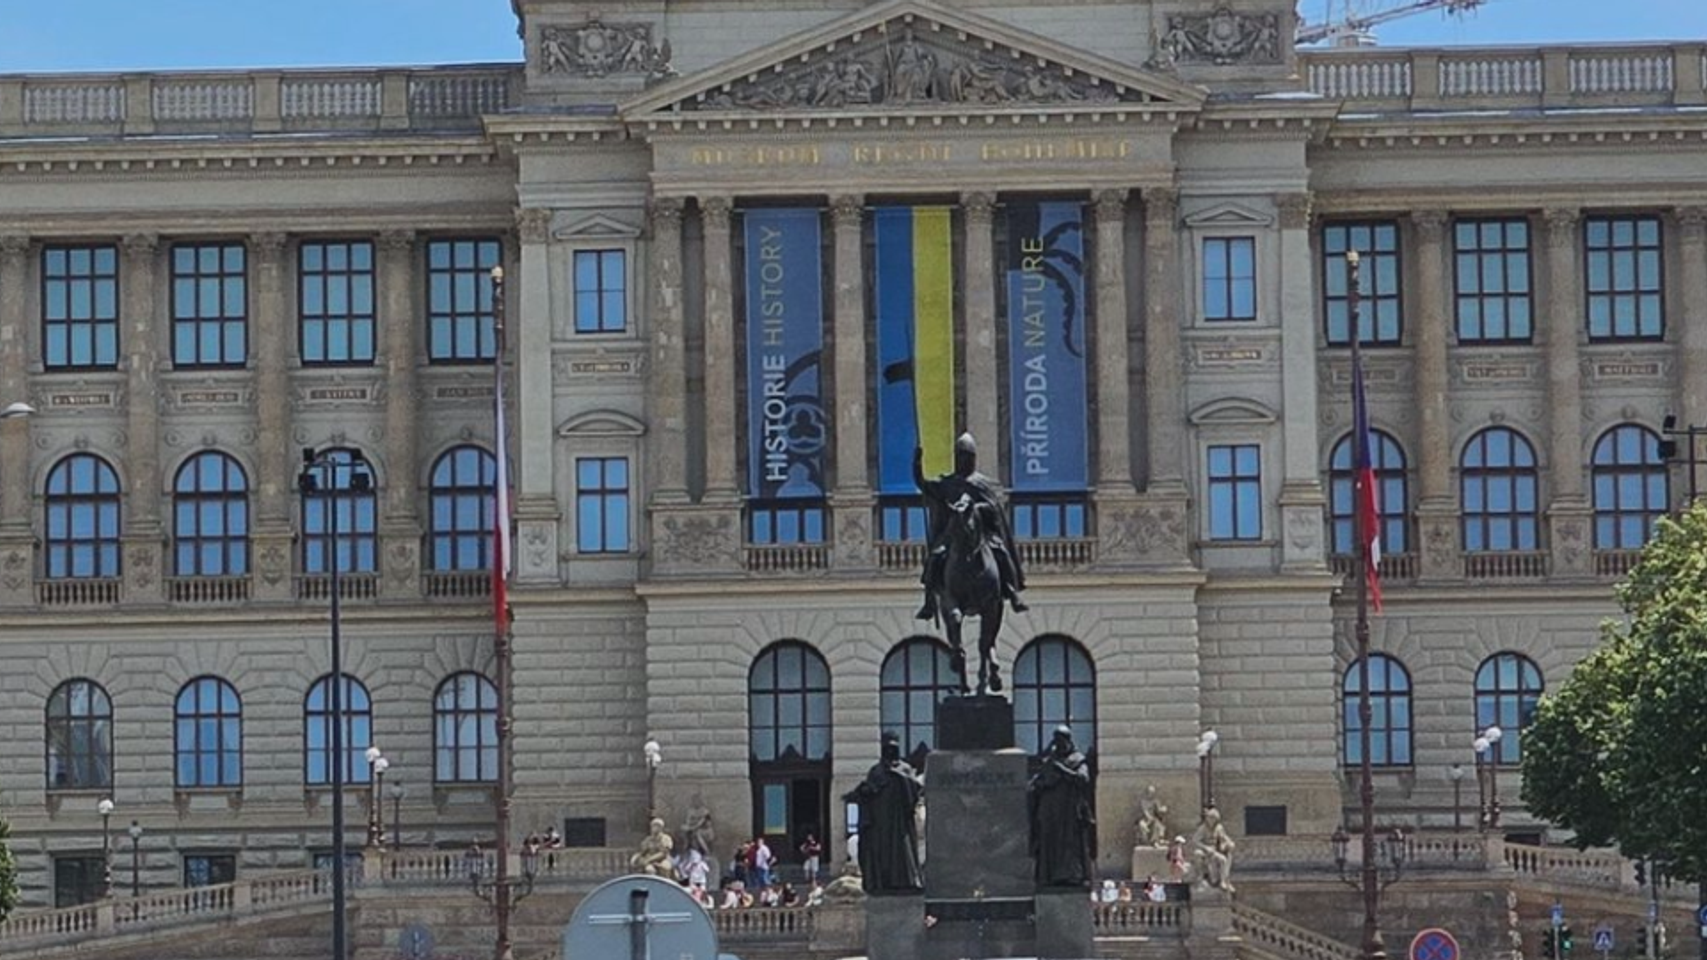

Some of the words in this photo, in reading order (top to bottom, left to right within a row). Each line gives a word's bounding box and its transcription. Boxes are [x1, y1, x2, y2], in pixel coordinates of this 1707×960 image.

[760, 226, 784, 346] HISTORY
[1021, 237, 1045, 347] NATURE
[762, 354, 788, 482] HISTORIE
[1020, 354, 1049, 475] PŘÍRODA
